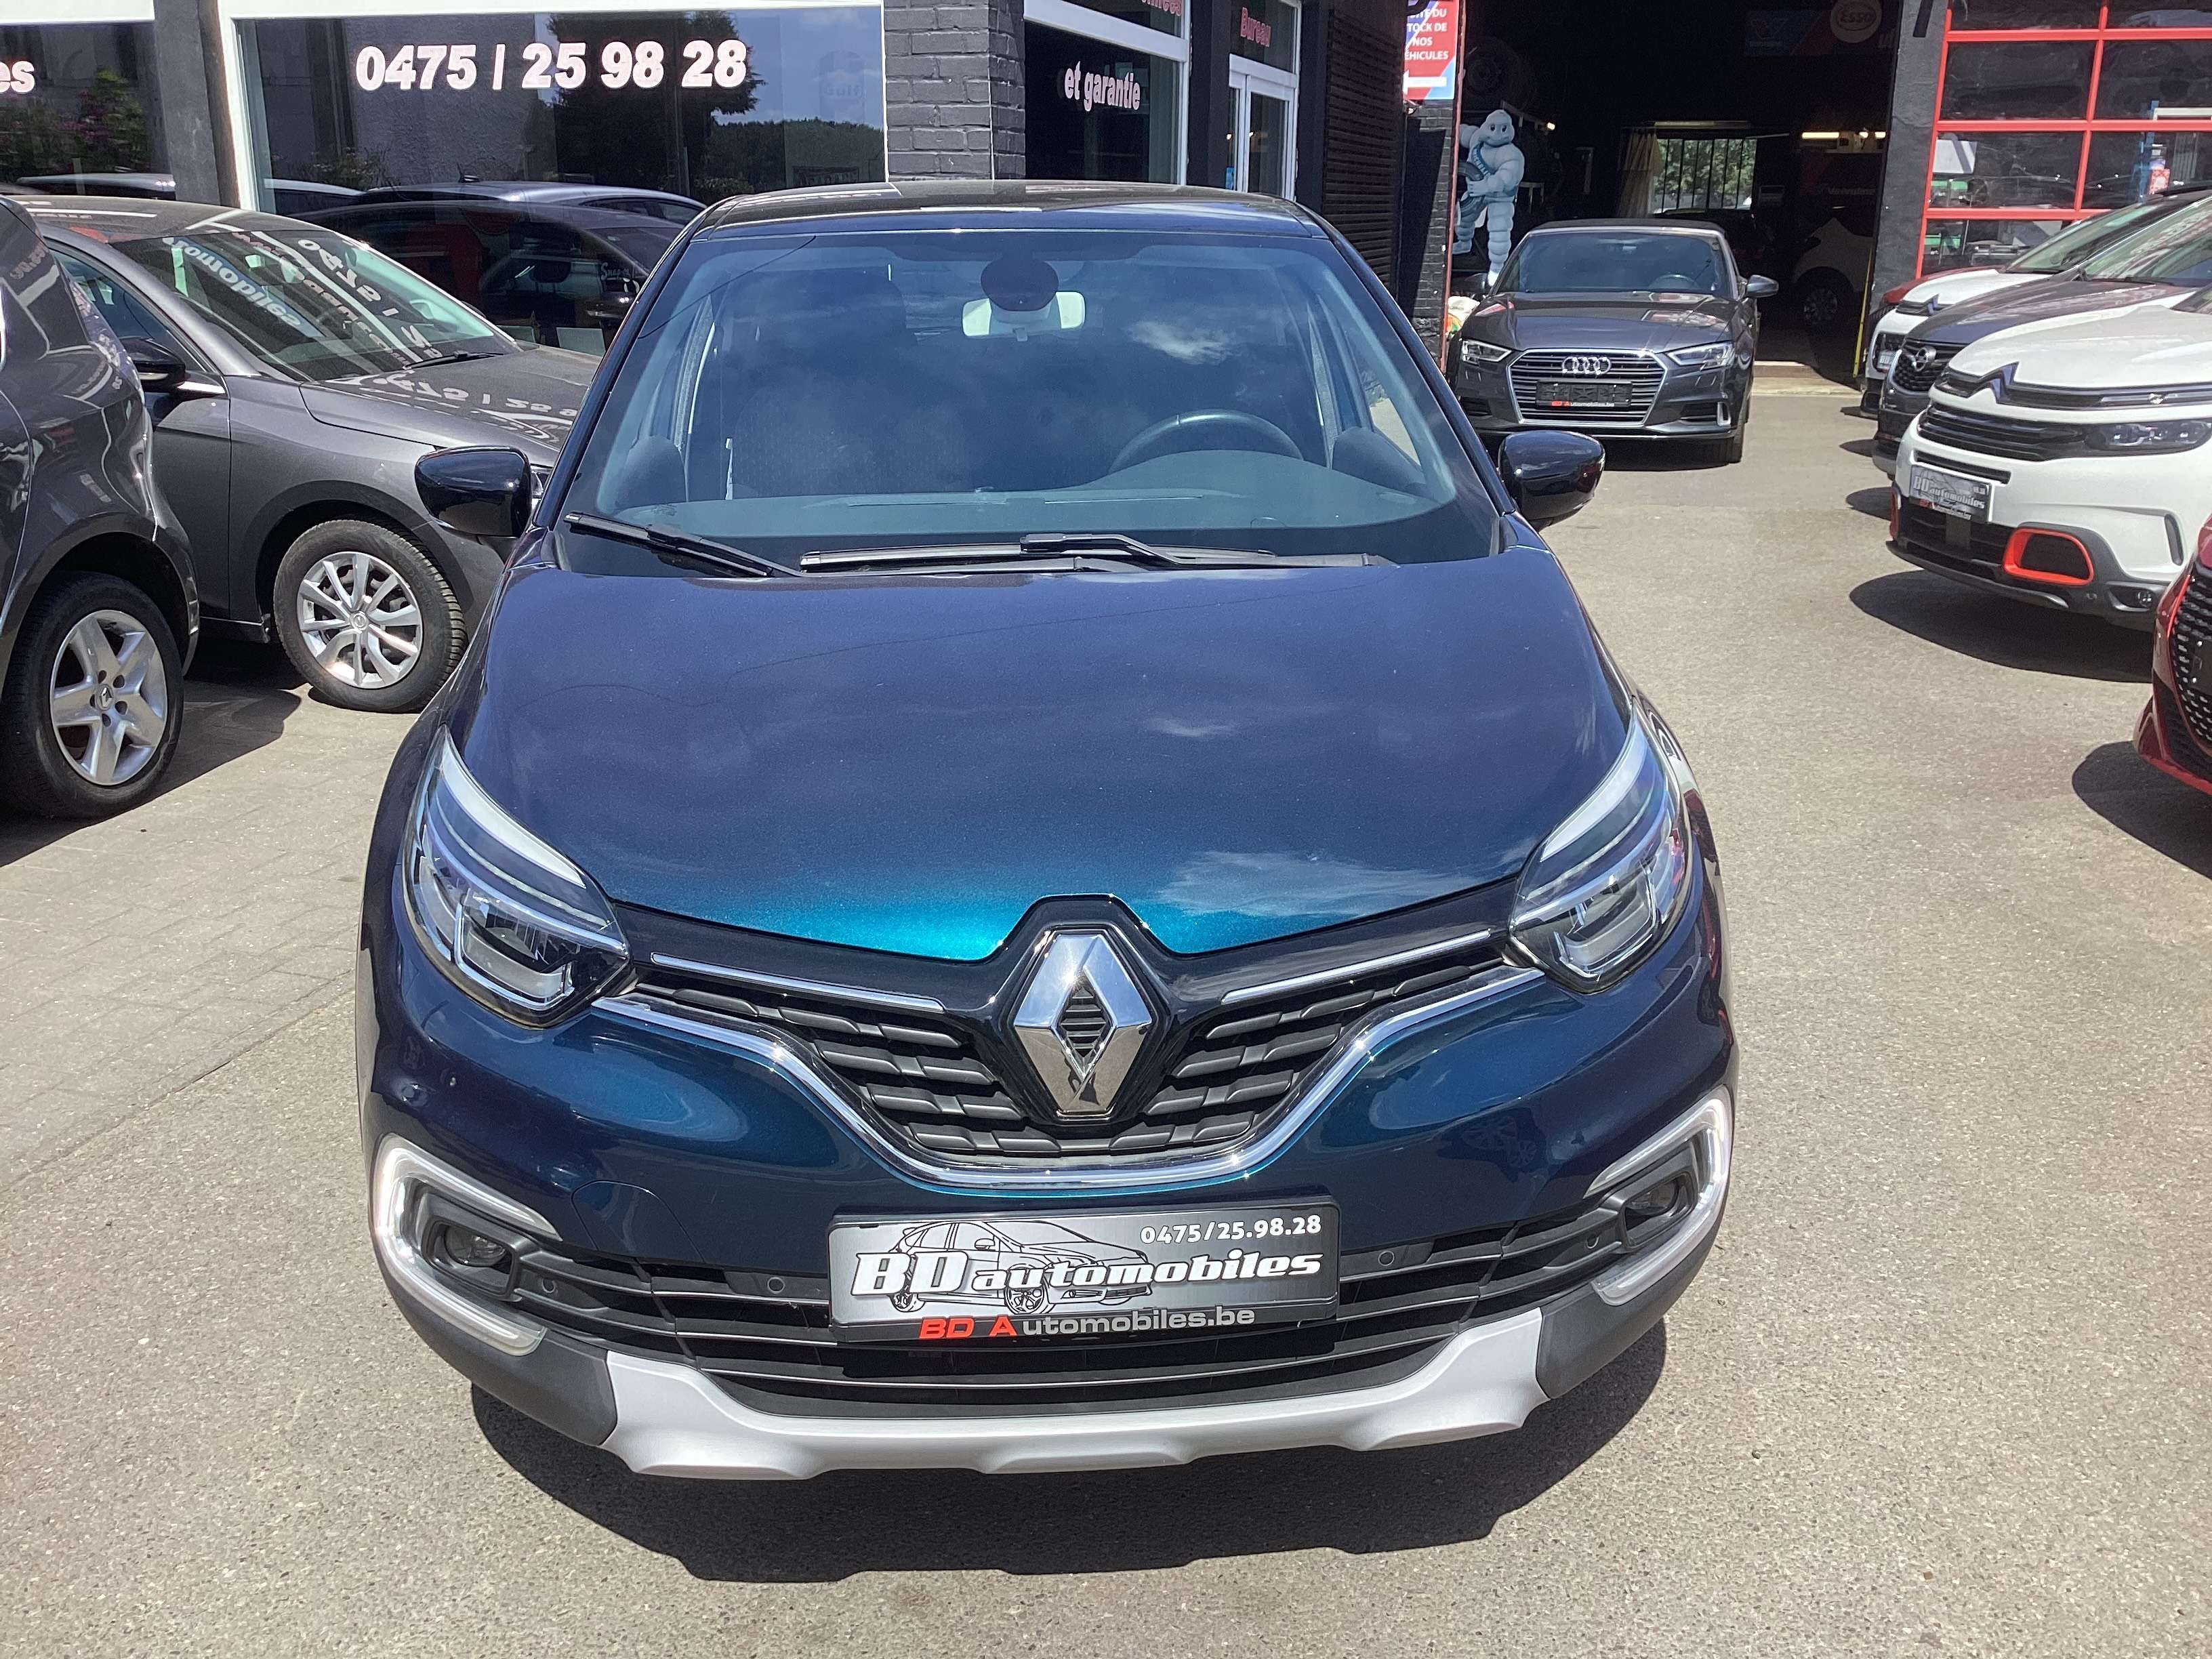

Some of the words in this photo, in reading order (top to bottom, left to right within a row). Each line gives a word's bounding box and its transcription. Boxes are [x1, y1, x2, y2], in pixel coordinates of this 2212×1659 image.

[1433, 8, 1448, 18] DU
[1240, 7, 1271, 47] Bureau
[1406, 23, 1433, 32] TOCK
[1434, 22, 1448, 31] DE
[1412, 37, 1433, 46] NOS
[356, 44, 477, 91] 0475
[521, 43, 586, 89] 25
[601, 41, 665, 88] 98
[681, 39, 747, 88] 28
[1404, 49, 1449, 60] ÉHICULES
[1065, 61, 1081, 100] et
[1084, 71, 1141, 112] garantie
[1140, 1214, 1322, 1244] 0475/25.98.28
[919, 1316, 975, 1339] BD
